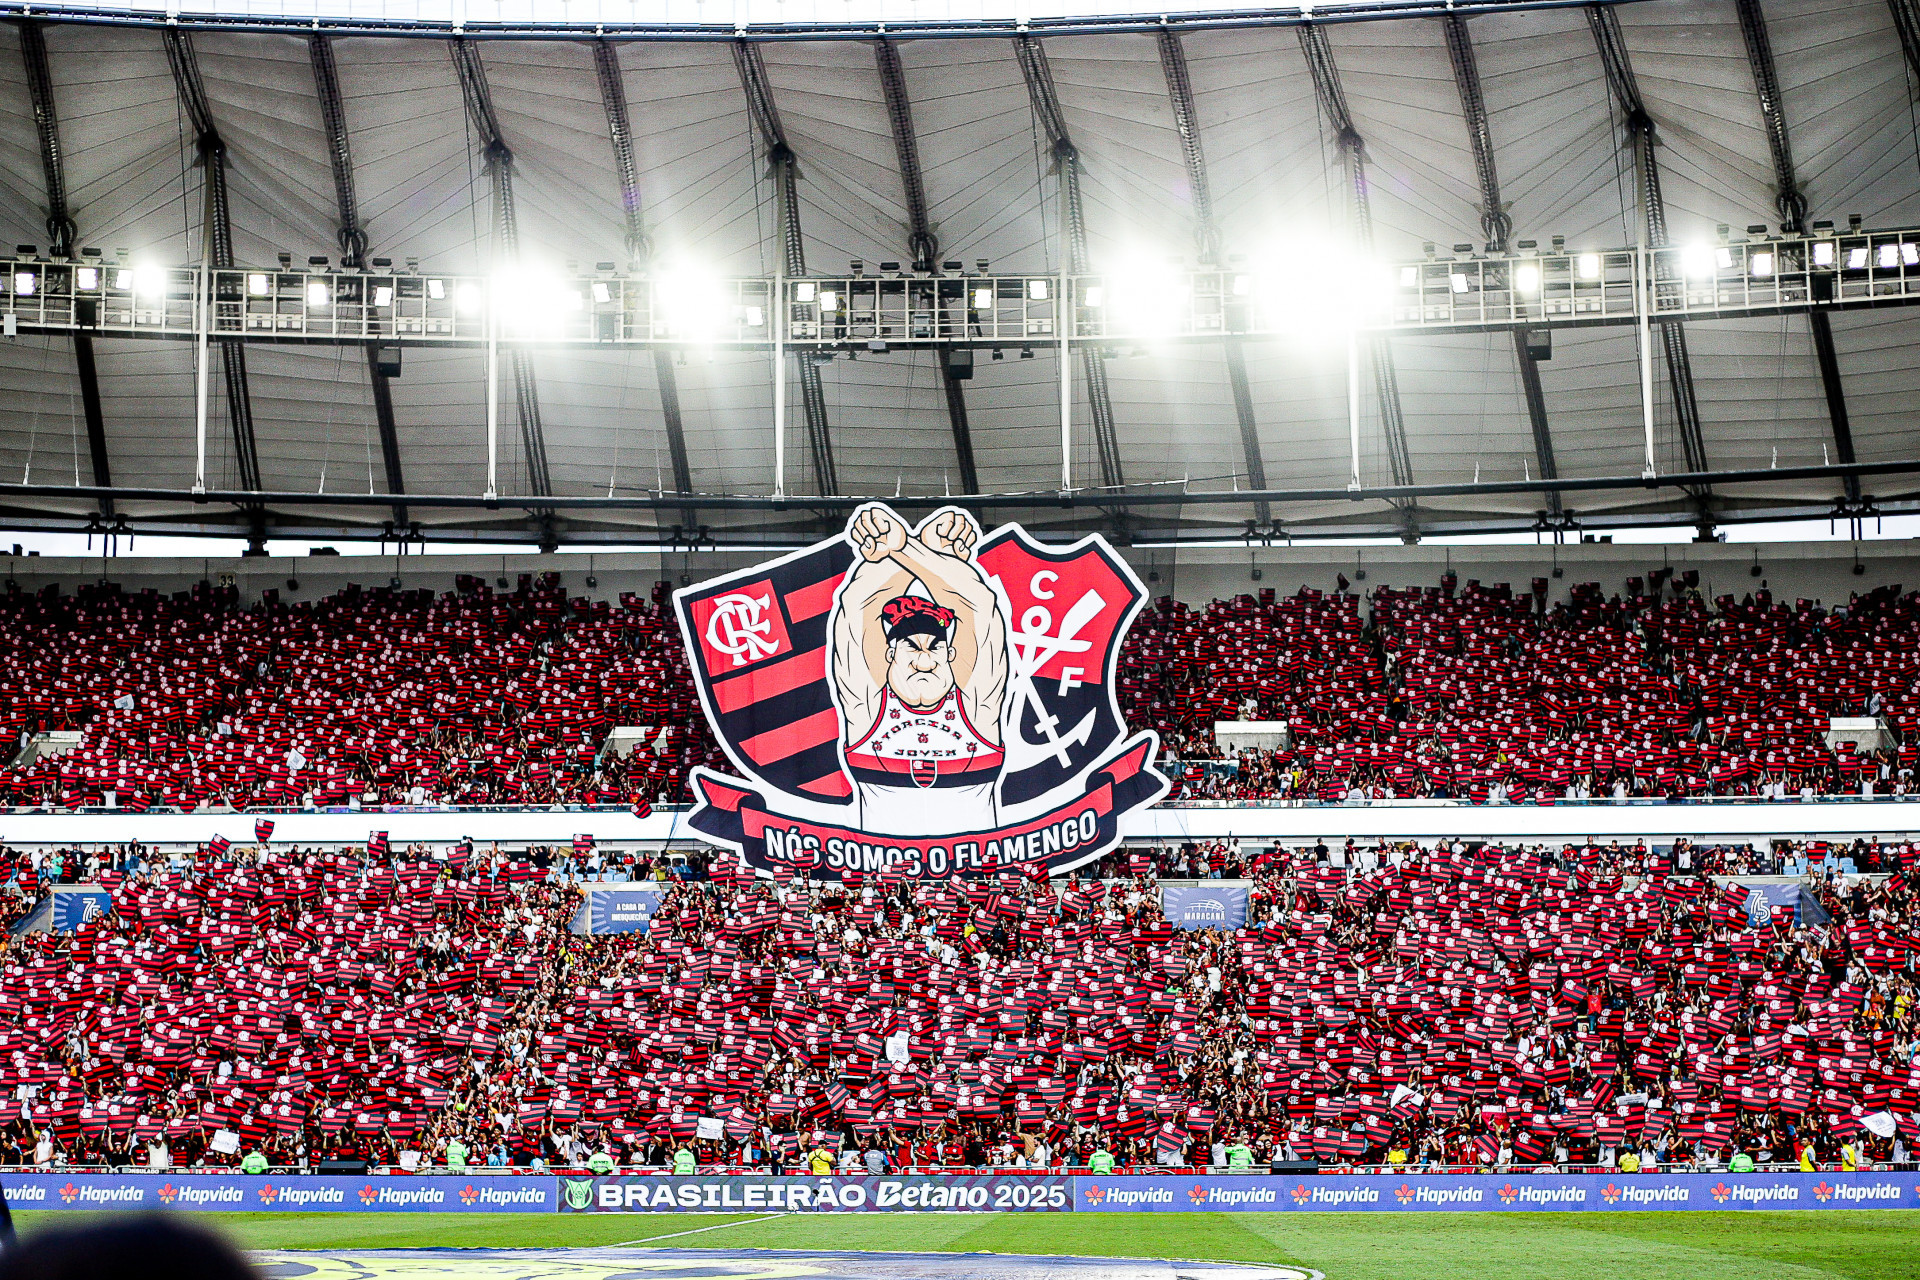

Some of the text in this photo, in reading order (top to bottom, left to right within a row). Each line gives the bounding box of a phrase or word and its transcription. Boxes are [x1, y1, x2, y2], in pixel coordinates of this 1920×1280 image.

[220, 575, 234, 586] 33
[1029, 570, 1059, 600] C
[1057, 666, 1085, 697] F
[881, 718, 963, 741] TORCIDA
[893, 749, 957, 757] JOVEM
[765, 810, 1097, 876] NÓS SOMOS O FLAMENGO
[616, 903, 621, 911] A
[637, 903, 646, 911] DO
[1184, 910, 1226, 921] MARACANÃ
[80, 1186, 143, 1204] Hapvida
[179, 1186, 243, 1204] Hapvida
[279, 1187, 343, 1205] Hapvida
[379, 1187, 444, 1205] Hapvida
[480, 1187, 545, 1206] Hapvida
[598, 1178, 1066, 1208] BRASILEIRÃO Betano 2025
[1106, 1184, 1901, 1206] Hapvida Hapvida Hapvida Hapvida Hapvida Hapvida Hapvida Hapvida
